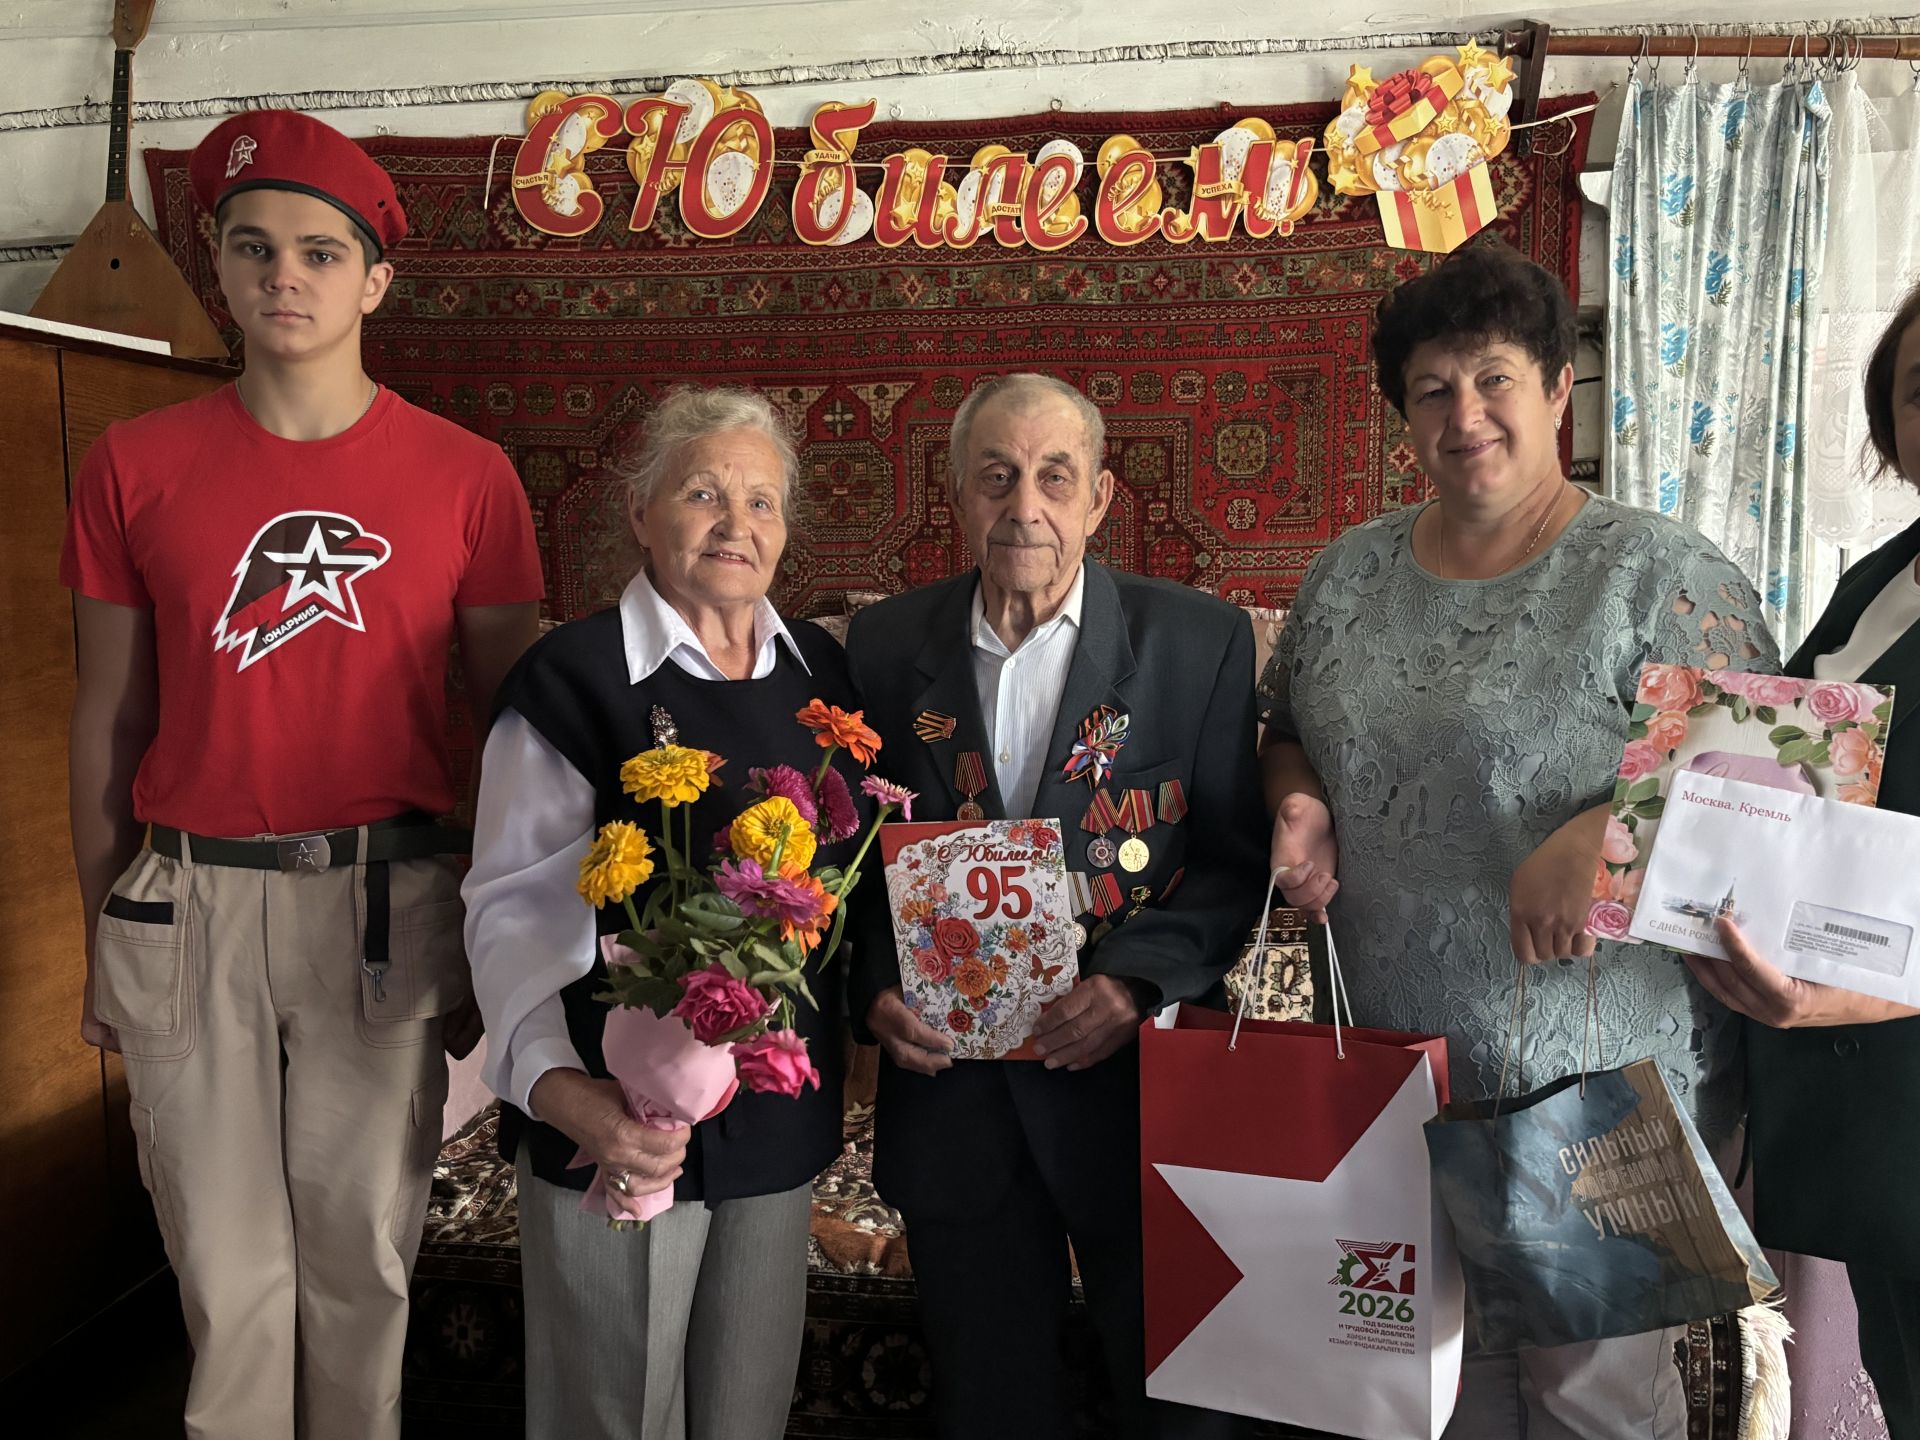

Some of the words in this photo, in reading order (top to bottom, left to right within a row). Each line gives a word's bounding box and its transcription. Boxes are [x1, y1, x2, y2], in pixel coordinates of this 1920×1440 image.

[512, 93, 623, 236] С
[815, 152, 840, 160] УДАЧИ
[515, 174, 549, 186] СЧАСТЬЯ
[1201, 182, 1233, 194] УСПЕХА
[261, 604, 319, 645] ЮНАРМИЯ
[1681, 790, 1735, 812] Москва.
[1739, 801, 1792, 823] Кремль
[959, 842, 1052, 863] Юбилеем!
[966, 865, 1033, 920] 95
[1649, 919, 1657, 928] С
[1558, 1115, 1671, 1176] СИЛЬНЫЙ
[1583, 1176, 1700, 1241] УМНЫЙ
[1338, 1289, 1415, 1323] 2026
[1344, 1324, 1379, 1335] ТРУДОВОЙ
[1380, 1329, 1415, 1340] ДОБЛЕСТИ
[1362, 1319, 1376, 1327] ГОД
[1377, 1321, 1415, 1333] ВОИНСКОЙ
